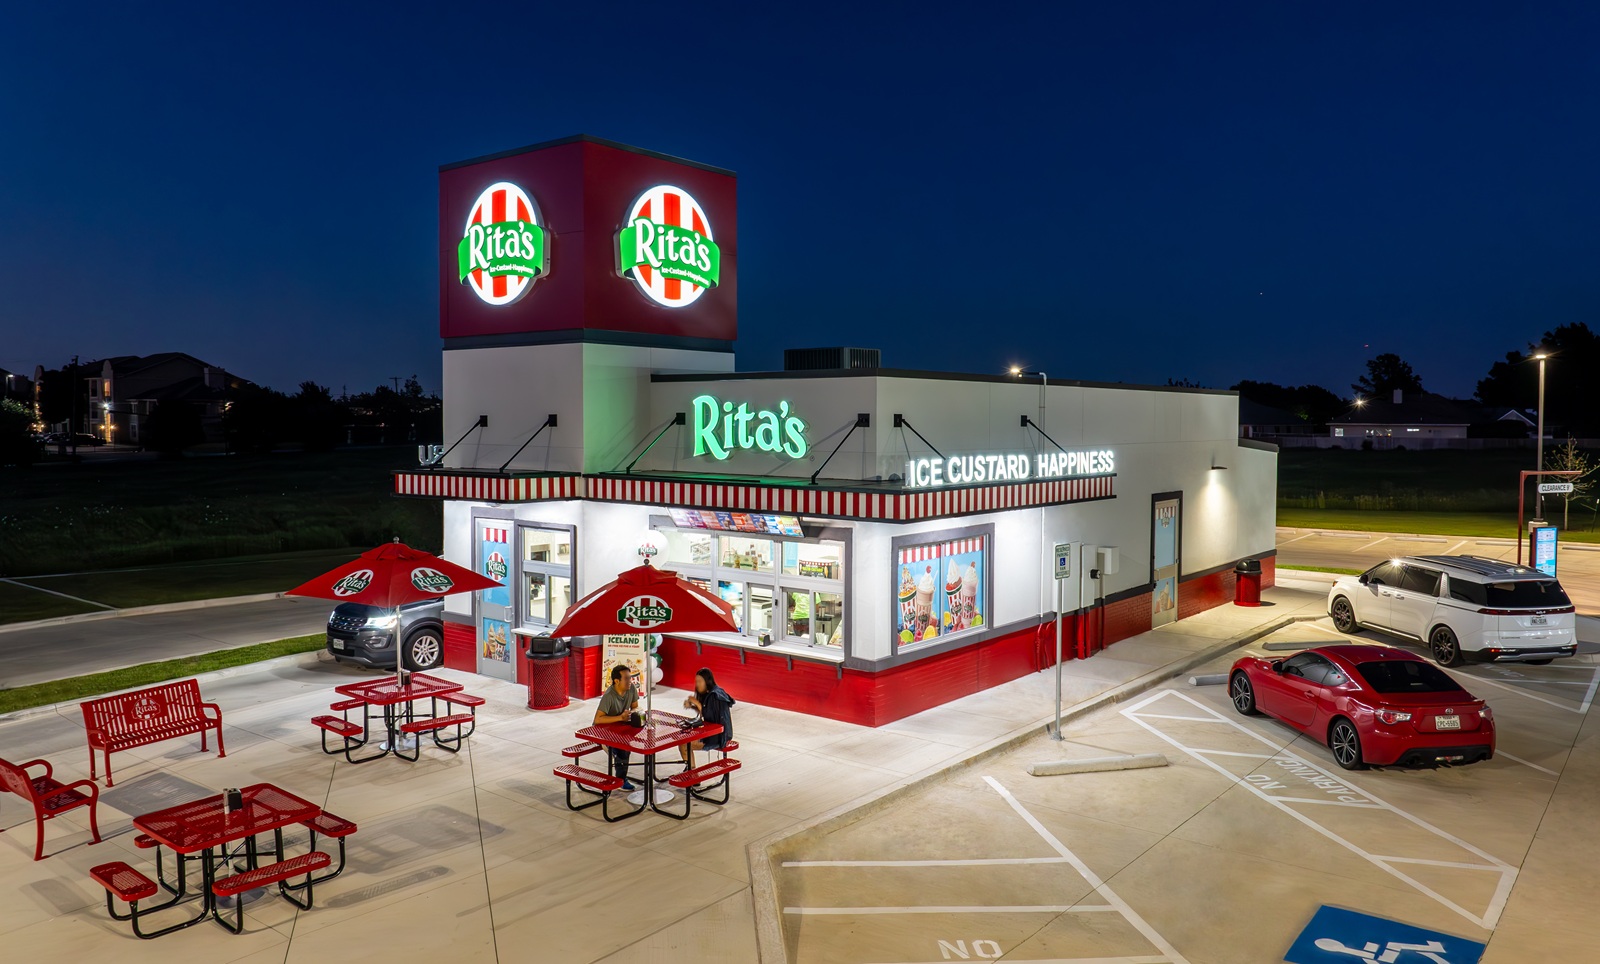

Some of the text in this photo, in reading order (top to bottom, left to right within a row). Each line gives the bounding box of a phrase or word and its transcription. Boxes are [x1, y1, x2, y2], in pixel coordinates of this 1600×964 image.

[469, 221, 535, 270] Rita's
[634, 218, 712, 272] Rita's
[692, 395, 807, 460] Rita's
[909, 450, 1115, 488] ICE CUSTARD HAPPINESS
[488, 560, 506, 574] Rita's
[340, 576, 367, 590] Rita's
[415, 576, 448, 589] Rita's
[625, 605, 667, 619] Rita's
[608, 636, 640, 645] ICELAND
[135, 703, 158, 716] Rita's
[1244, 774, 1288, 790] NO
[1276, 760, 1370, 804] PARKING
[937, 939, 1004, 959] NO
